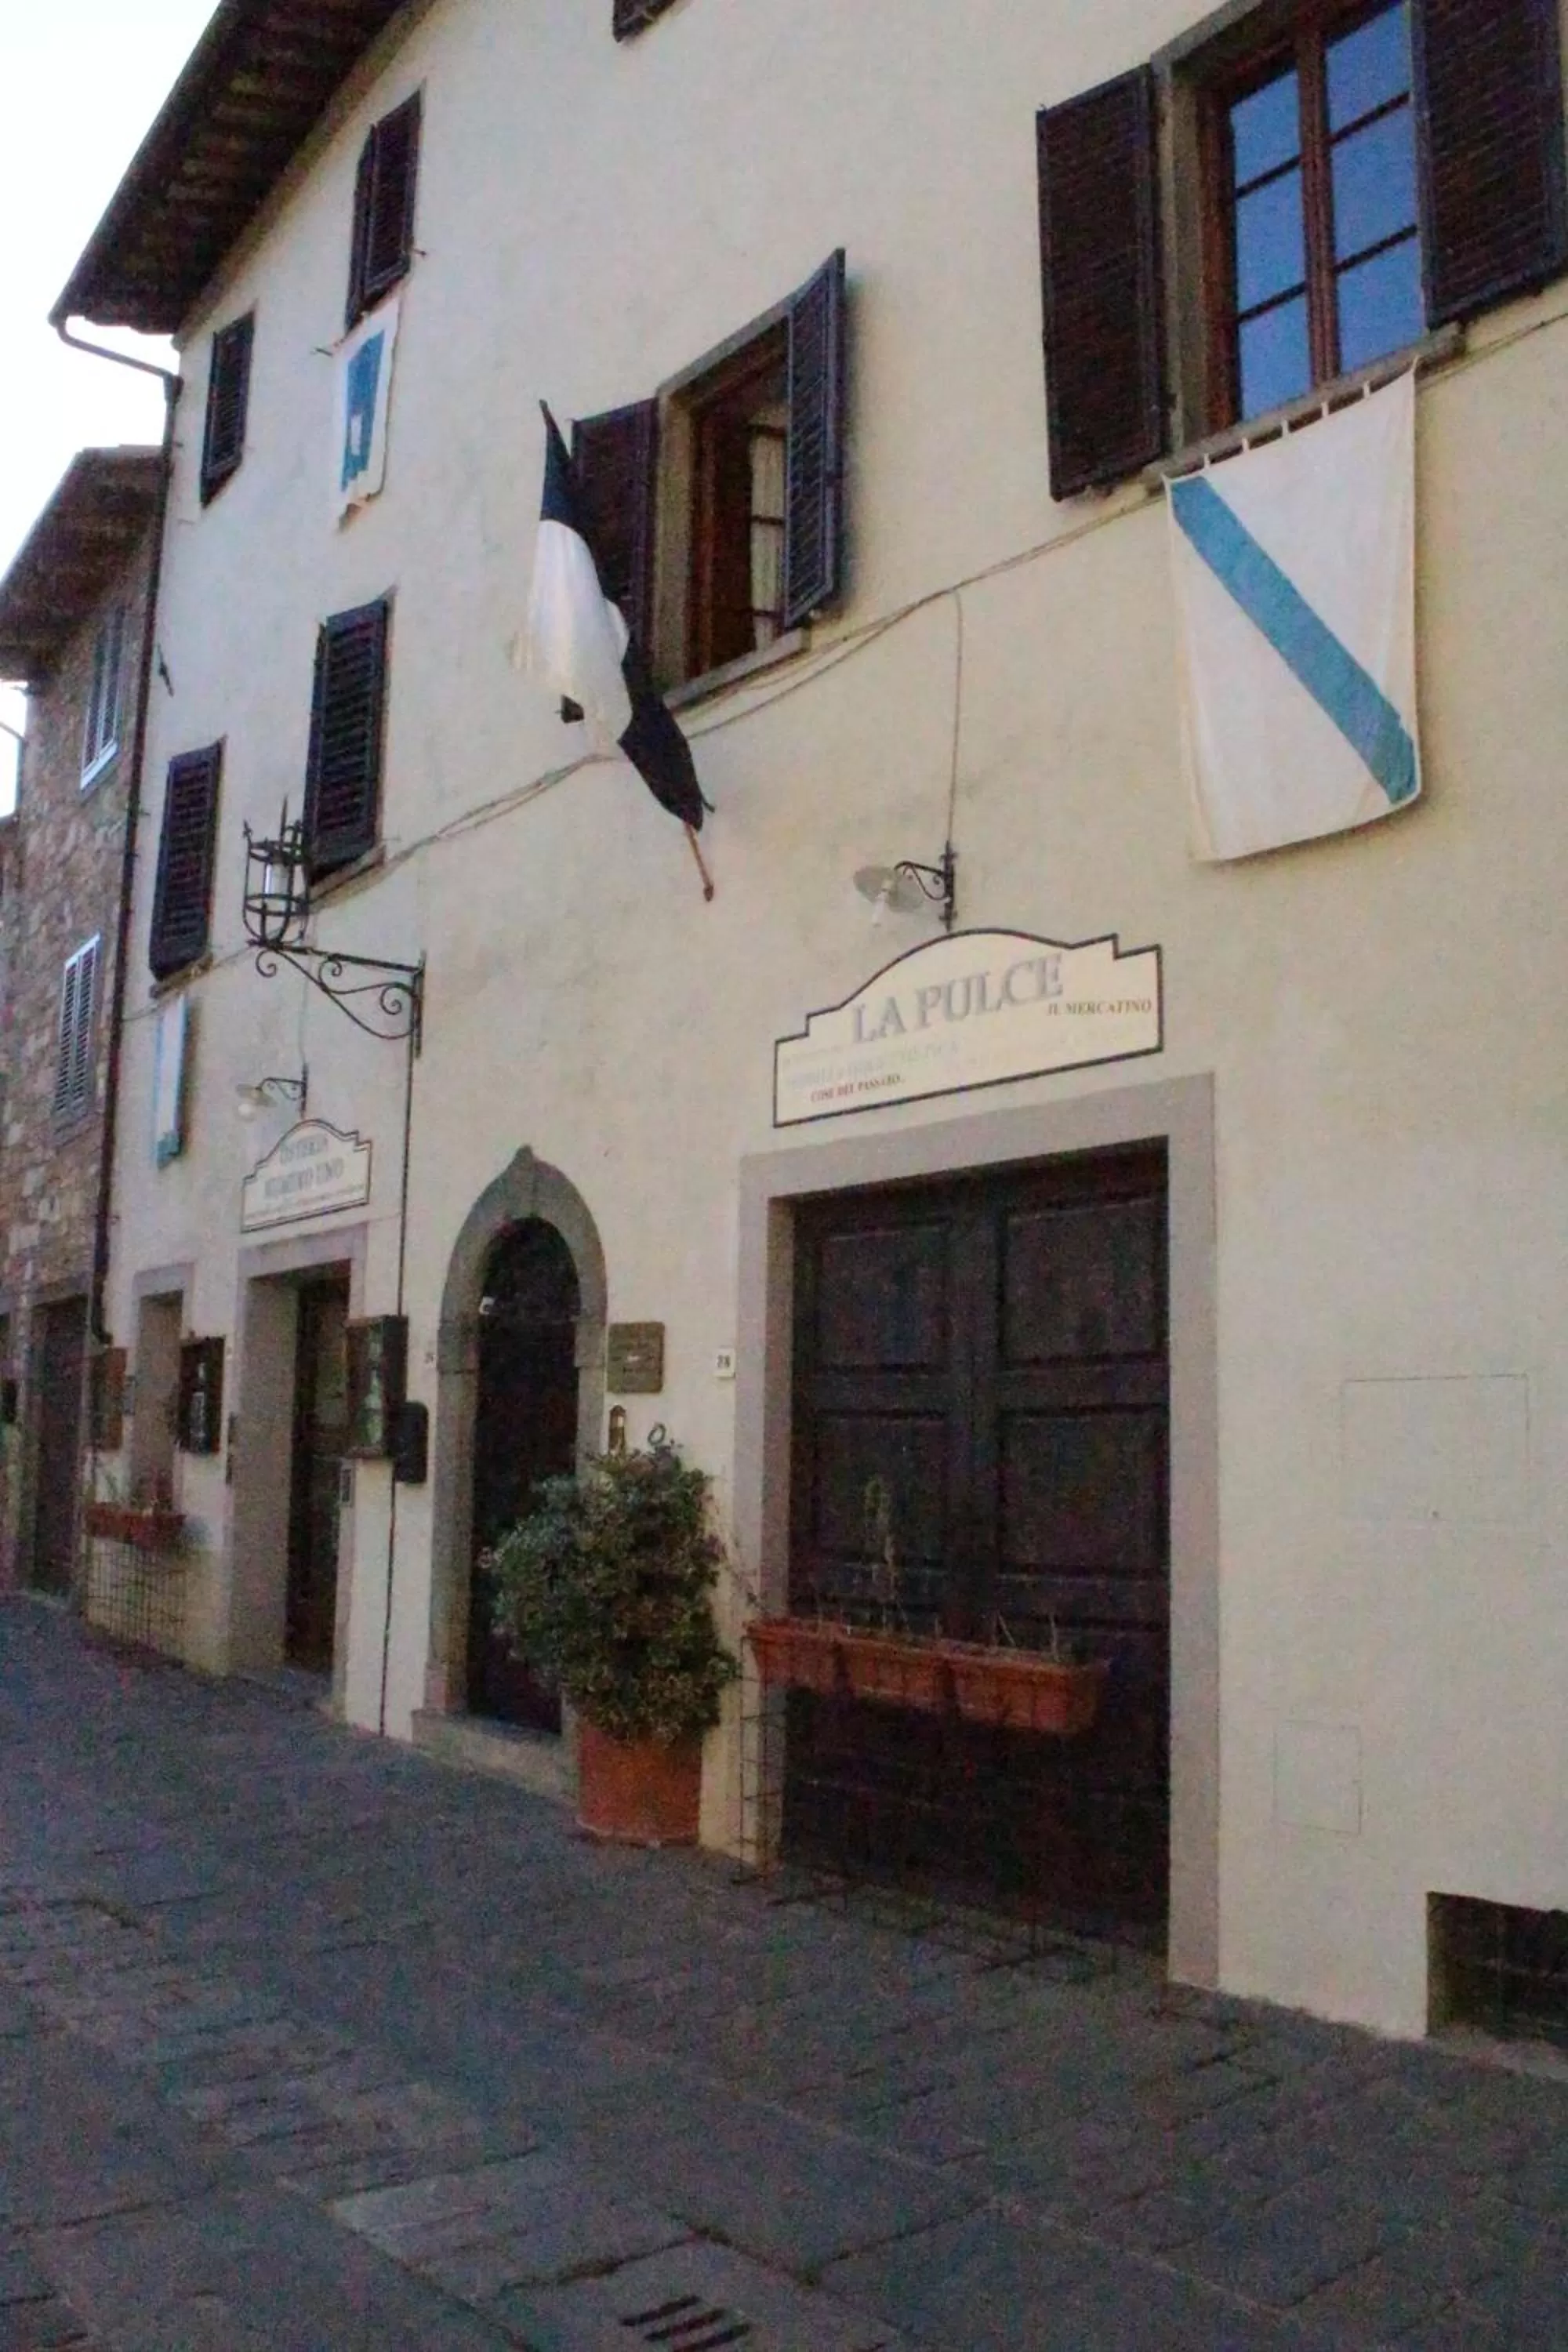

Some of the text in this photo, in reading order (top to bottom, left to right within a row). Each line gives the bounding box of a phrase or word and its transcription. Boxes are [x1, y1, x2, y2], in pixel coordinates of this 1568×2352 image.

[851, 951, 1064, 1044] LA PULCE
[1065, 997, 1152, 1017] MERCATINO
